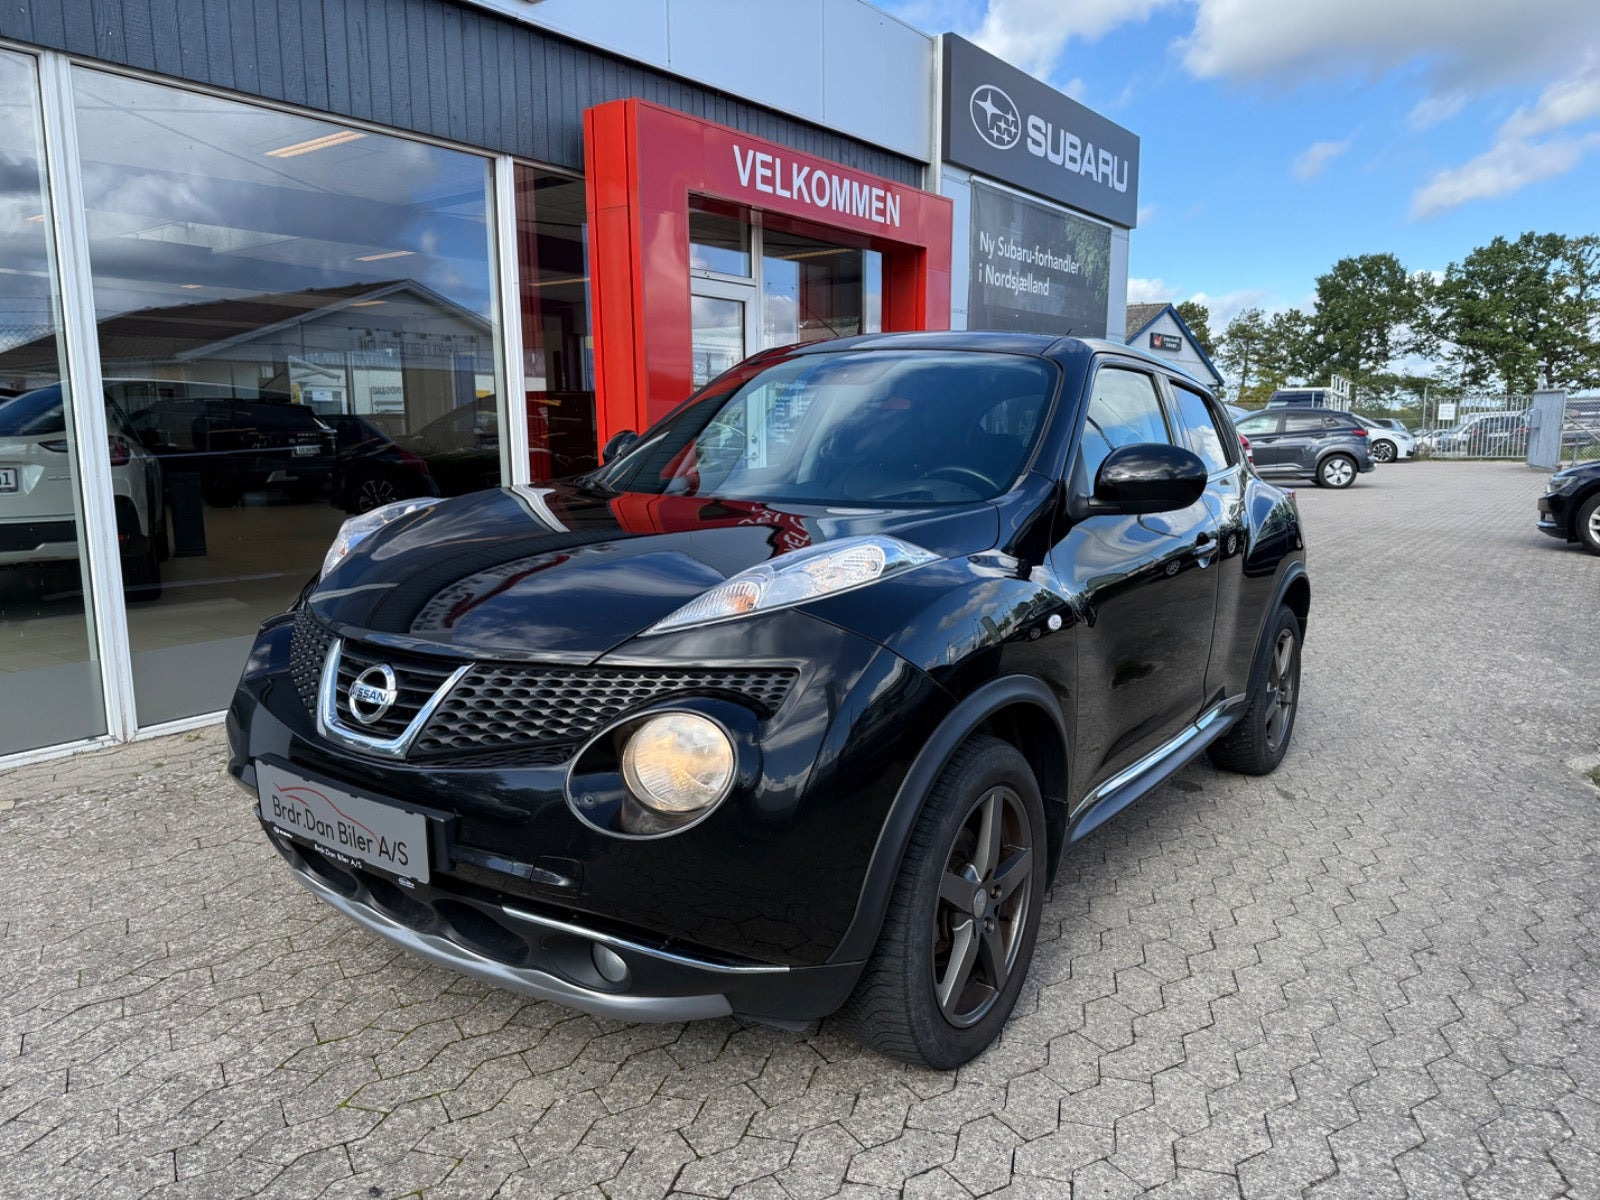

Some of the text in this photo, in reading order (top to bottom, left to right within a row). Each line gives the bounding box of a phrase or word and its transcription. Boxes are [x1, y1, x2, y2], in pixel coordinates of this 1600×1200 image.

[1027, 115, 1128, 193] SUBARU
[733, 144, 900, 227] VELKOMMEN
[979, 231, 1080, 275] Ny Subaru-forhandler
[978, 262, 1050, 296] i Nordsjælland
[351, 682, 387, 702] NISSAN
[337, 821, 374, 854] Biler
[378, 836, 409, 866] A/S
